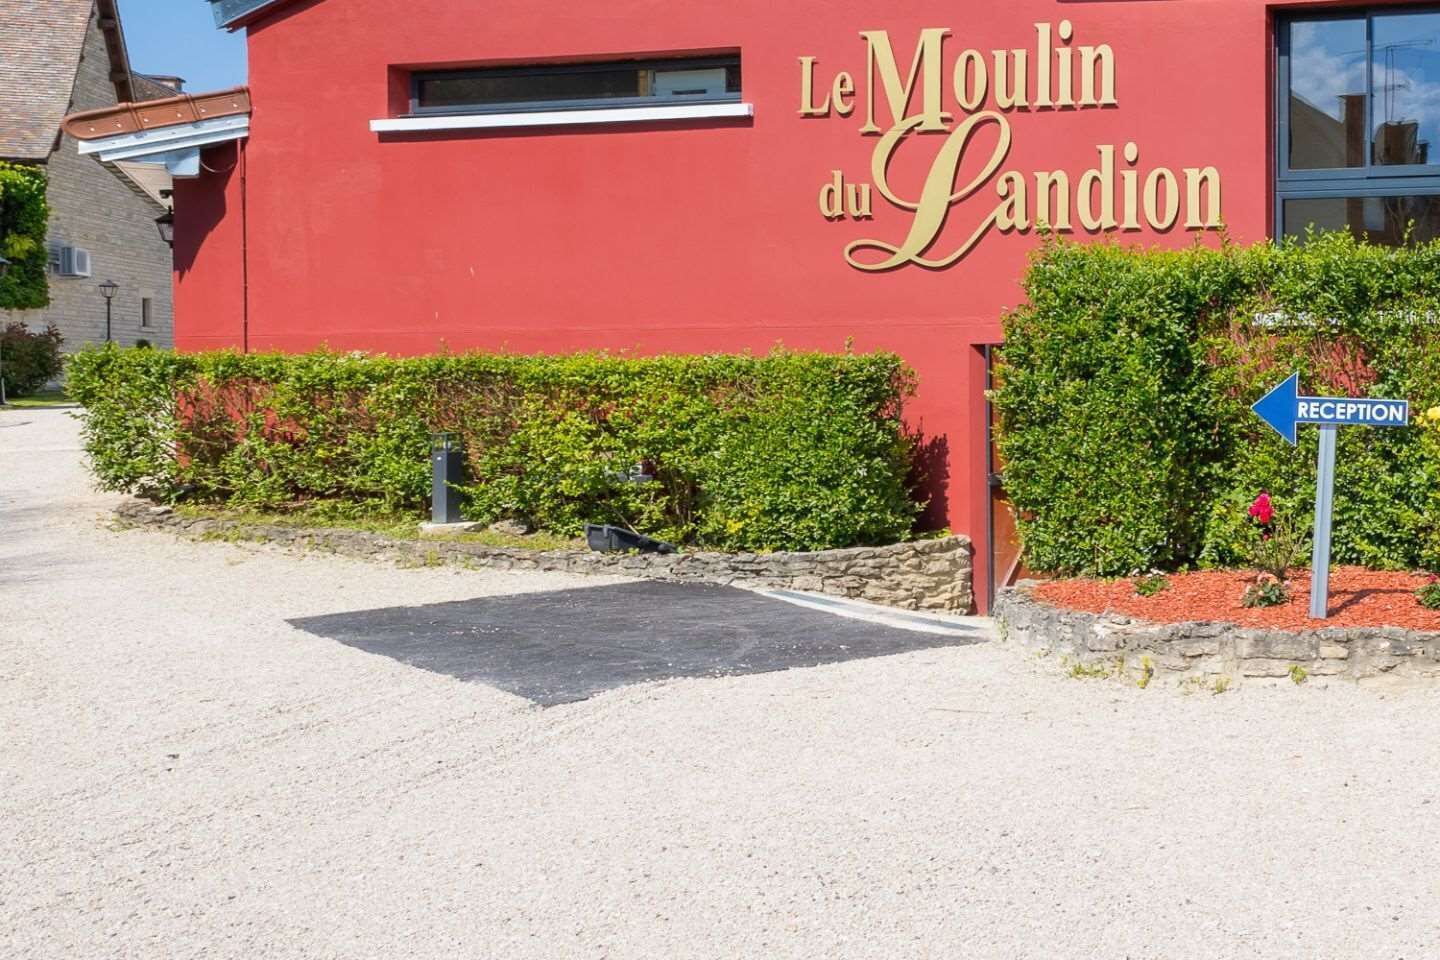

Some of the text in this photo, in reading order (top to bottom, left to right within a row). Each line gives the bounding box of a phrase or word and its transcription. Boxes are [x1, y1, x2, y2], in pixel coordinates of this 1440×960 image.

[798, 19, 1117, 133] Le Moulin
[819, 110, 1222, 270] du Landion
[1297, 401, 1403, 422] RECEPTION
